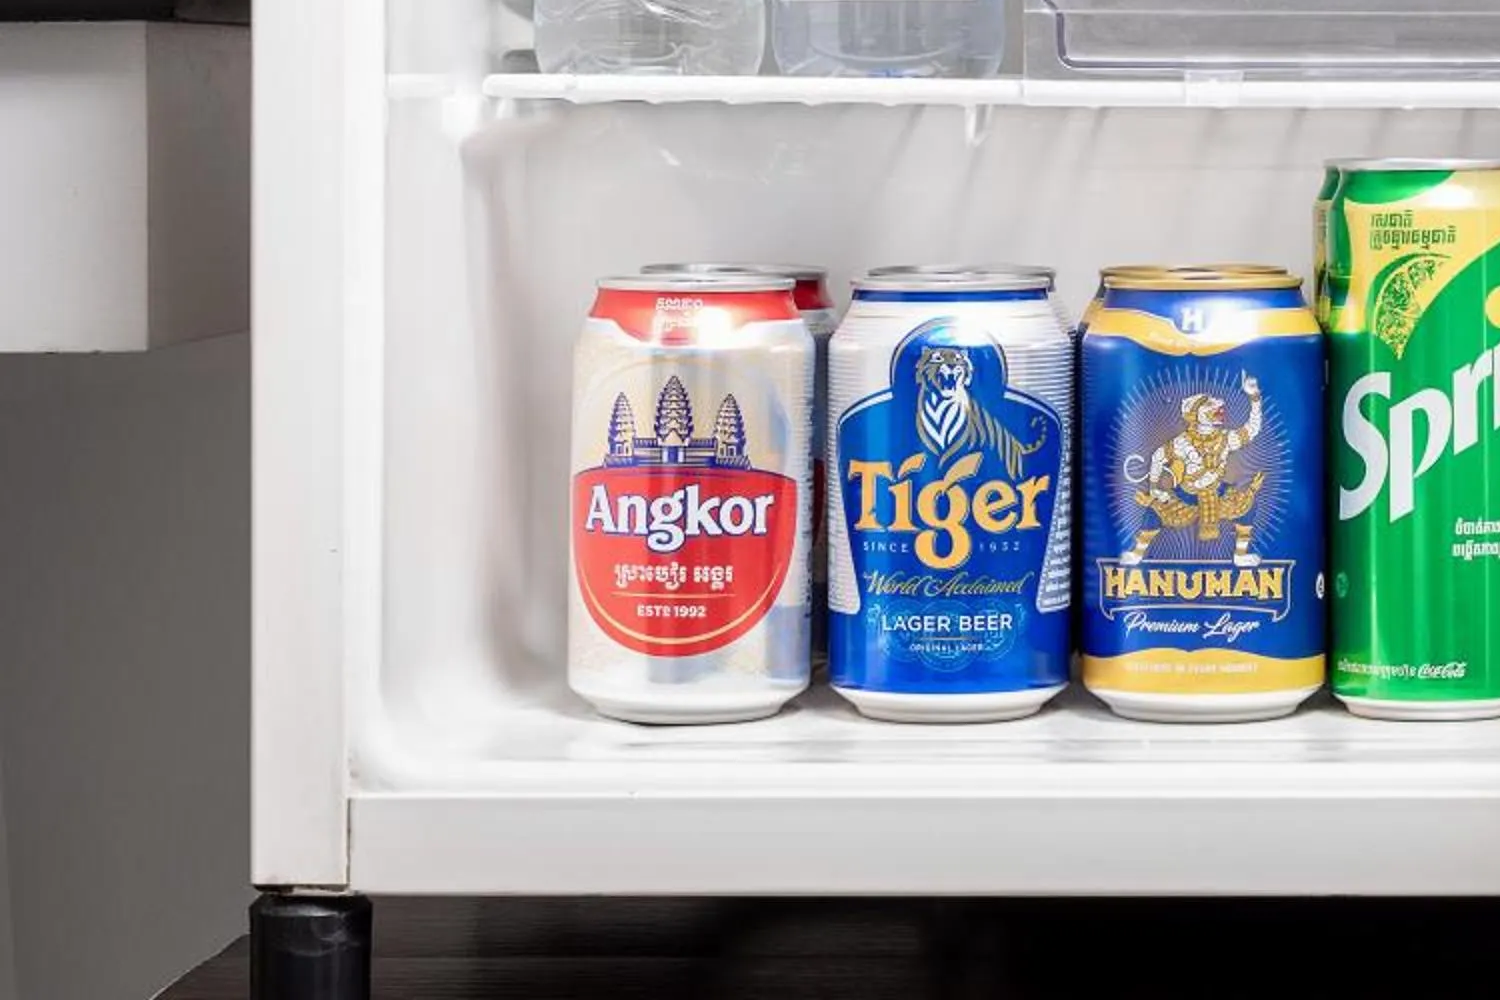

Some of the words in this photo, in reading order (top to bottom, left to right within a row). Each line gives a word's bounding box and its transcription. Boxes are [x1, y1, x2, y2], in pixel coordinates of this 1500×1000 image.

[585, 484, 775, 552] Angkor
[848, 452, 1050, 571] Tiger
[863, 541, 910, 553] SINCE
[978, 541, 1021, 553] 1932
[863, 569, 923, 596] World
[924, 571, 1034, 597] Acclaimed
[1104, 566, 1284, 600] HANUMAN
[674, 605, 707, 618] 1992
[882, 614, 951, 632] LAGER
[959, 613, 1013, 632] BEER
[1123, 611, 1200, 639] Premium
[1203, 611, 1260, 643] Lager
